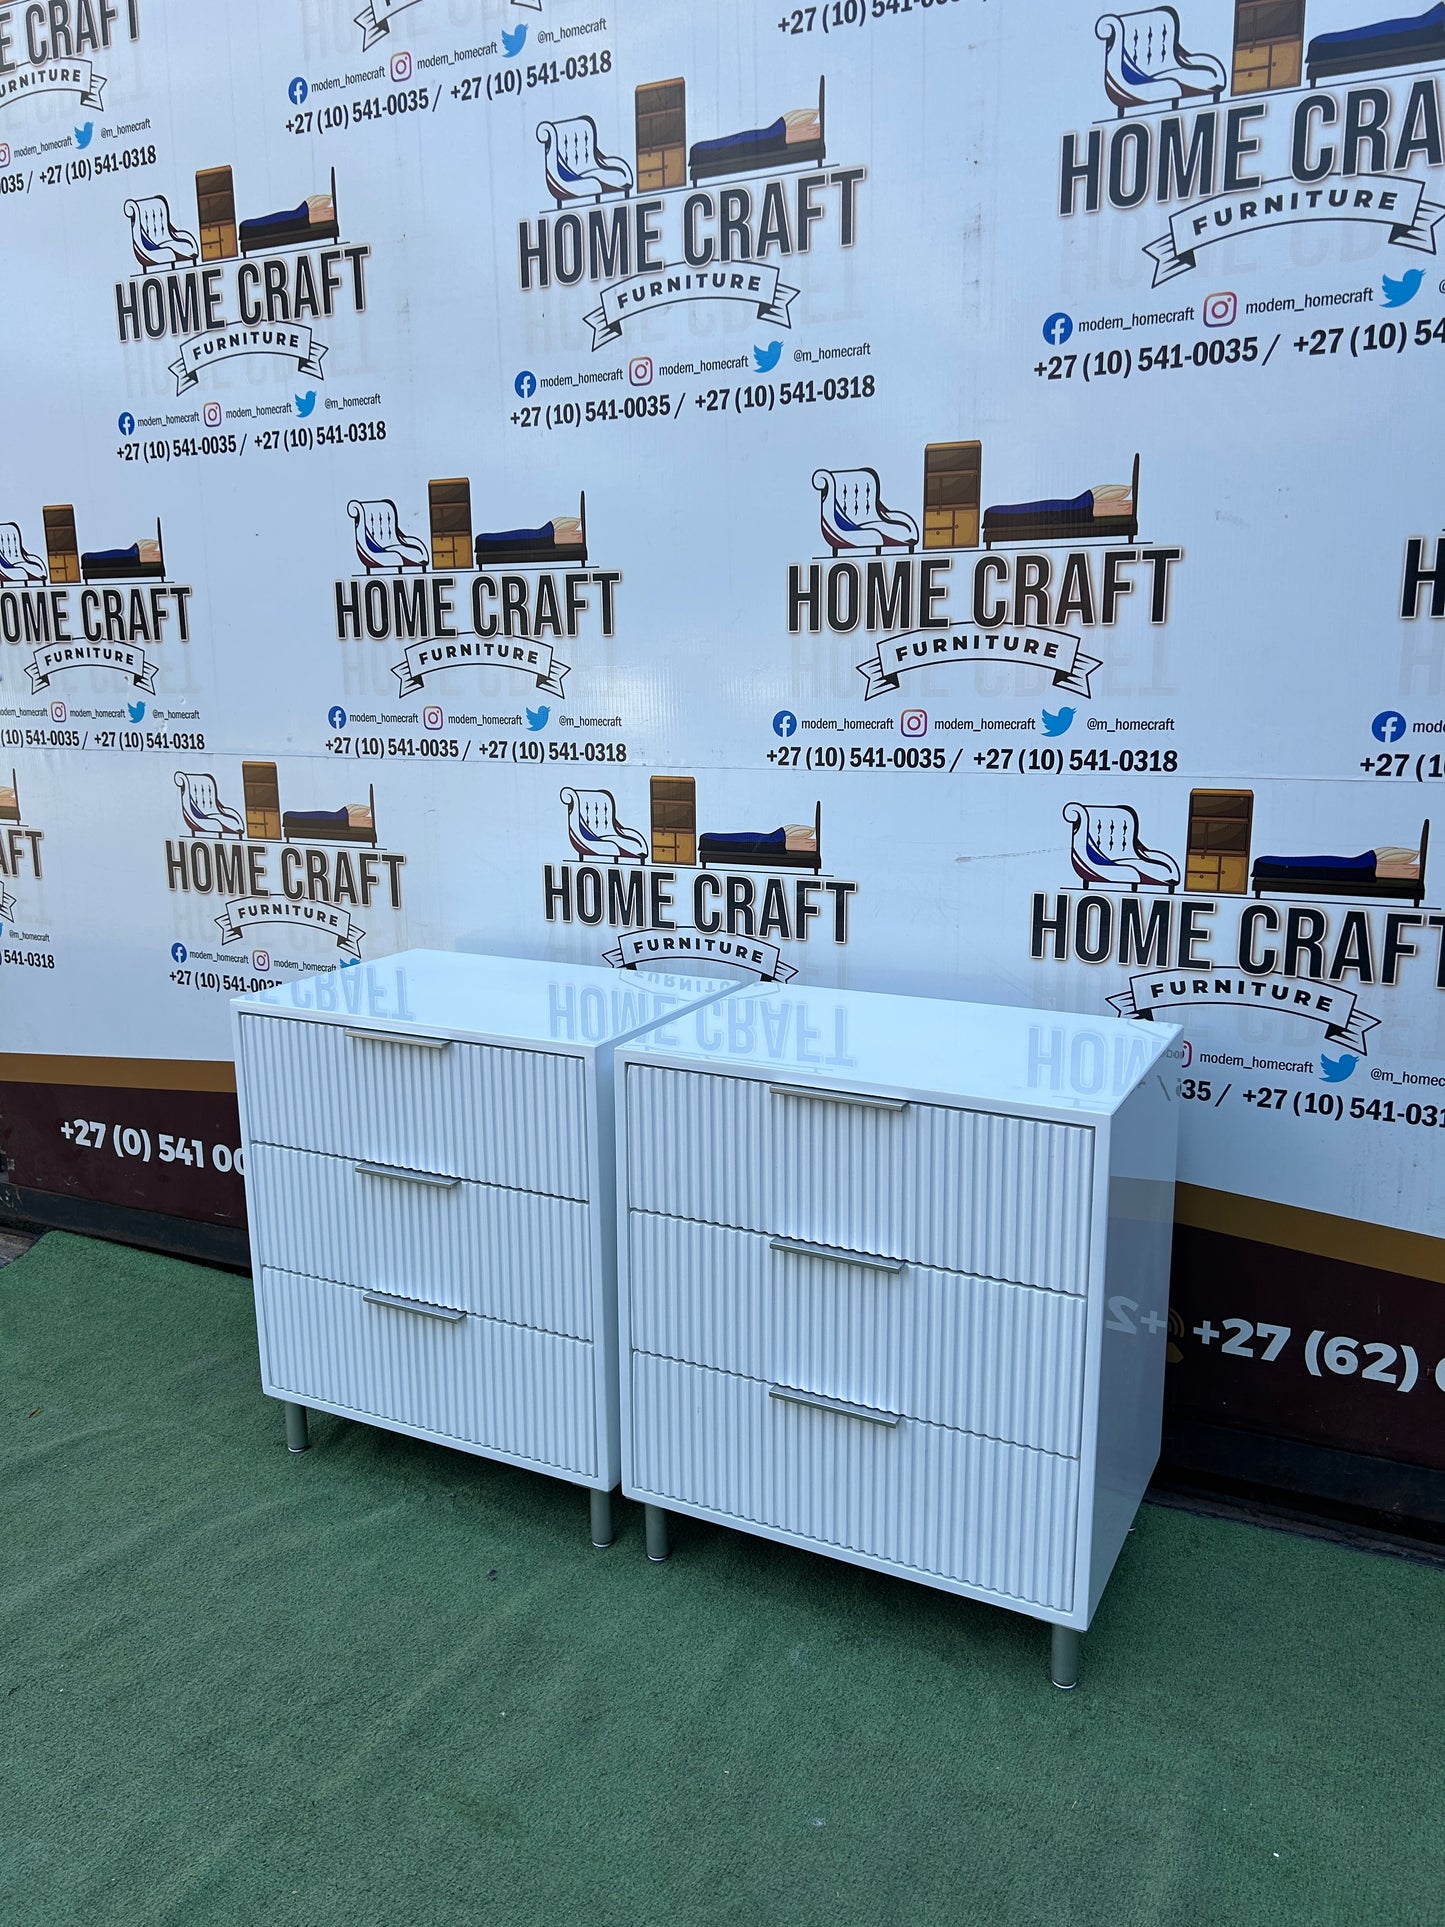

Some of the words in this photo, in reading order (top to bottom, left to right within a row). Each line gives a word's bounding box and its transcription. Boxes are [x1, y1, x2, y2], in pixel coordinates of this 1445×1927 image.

[778, 7, 817, 35] +27
[822, 0, 866, 34] (10)
[0, 69, 81, 98] URNITURE
[285, 112, 314, 135] +27
[317, 104, 350, 135] (10)
[352, 87, 429, 124] 541-0035
[450, 78, 481, 102] +27
[486, 67, 522, 100] (10)
[526, 50, 612, 88] 541-0318
[40, 165, 62, 185] +27
[66, 158, 92, 185] (10)
[94, 145, 157, 175] 541-0318
[1059, 103, 1267, 216] HOME
[518, 199, 664, 289] HOME
[683, 167, 866, 268] CRAFT
[1192, 188, 1399, 236] FURNITURE
[115, 267, 226, 342] HOME
[237, 245, 370, 326] CRAFT
[617, 273, 762, 309] FURNITURE
[193, 331, 300, 360] FURNITURE
[1034, 355, 1078, 381] +27
[1083, 348, 1132, 382] (10)
[1137, 336, 1259, 372] 541-0035
[1294, 327, 1344, 356] +27
[1350, 321, 1408, 358] (10)
[510, 406, 541, 429] +27
[545, 401, 581, 430] (10)
[585, 393, 671, 422] 541-0035
[695, 388, 731, 412] +27
[735, 383, 775, 414] (10)
[779, 374, 876, 406] 541-0318
[116, 443, 140, 461] +27
[144, 440, 170, 463] (10)
[173, 434, 237, 458] 541-0035
[254, 430, 280, 450] +27
[284, 427, 313, 451] (10)
[316, 421, 387, 445] 541-0318
[334, 577, 458, 640] HOME
[471, 571, 621, 639] CRAFT
[787, 558, 953, 633] HOME
[972, 547, 1182, 629] CRAFT
[0, 589, 72, 644] OME
[81, 585, 192, 645] CRAFT
[44, 647, 135, 666] FURNITURE
[419, 643, 538, 665] FURNITURE
[895, 635, 1060, 662] FURNITURE
[1, 729, 24, 748] (10)
[26, 729, 80, 747] 541-0035
[94, 732, 116, 748] +27
[119, 732, 144, 751] (10)
[146, 732, 205, 750] 541-0318
[325, 736, 351, 755] +27
[355, 737, 385, 759] (10)
[388, 738, 459, 758] 541-0035
[479, 740, 508, 759] +27
[512, 740, 545, 763] (10)
[549, 742, 627, 762] 541-0318
[766, 747, 801, 767] +27
[806, 746, 845, 771] (10)
[849, 747, 945, 770] 541-0035
[973, 748, 1013, 771] +27
[1018, 748, 1063, 775] (10)
[1069, 749, 1178, 773] 541-0318
[1360, 753, 1410, 777] +27
[165, 839, 271, 898] HOME
[280, 847, 407, 909] CRAFT
[237, 903, 339, 927] FURNITURE
[543, 864, 677, 930] HOME
[693, 873, 857, 944] CRAFT
[632, 937, 764, 964] FURNITURE
[1029, 892, 1216, 972] HOME
[4, 949, 55, 969] 541-0318
[169, 971, 192, 987] +27
[194, 971, 220, 993] (10)
[1150, 979, 1333, 1013] FURNITURE
[1242, 1088, 1288, 1111] +27
[1293, 1090, 1344, 1121] (10)
[60, 1118, 107, 1149] +27
[112, 1124, 151, 1163] (0)
[158, 1133, 205, 1169] 541
[1193, 1317, 1292, 1362] +27
[1304, 1330, 1420, 1394] (62)
